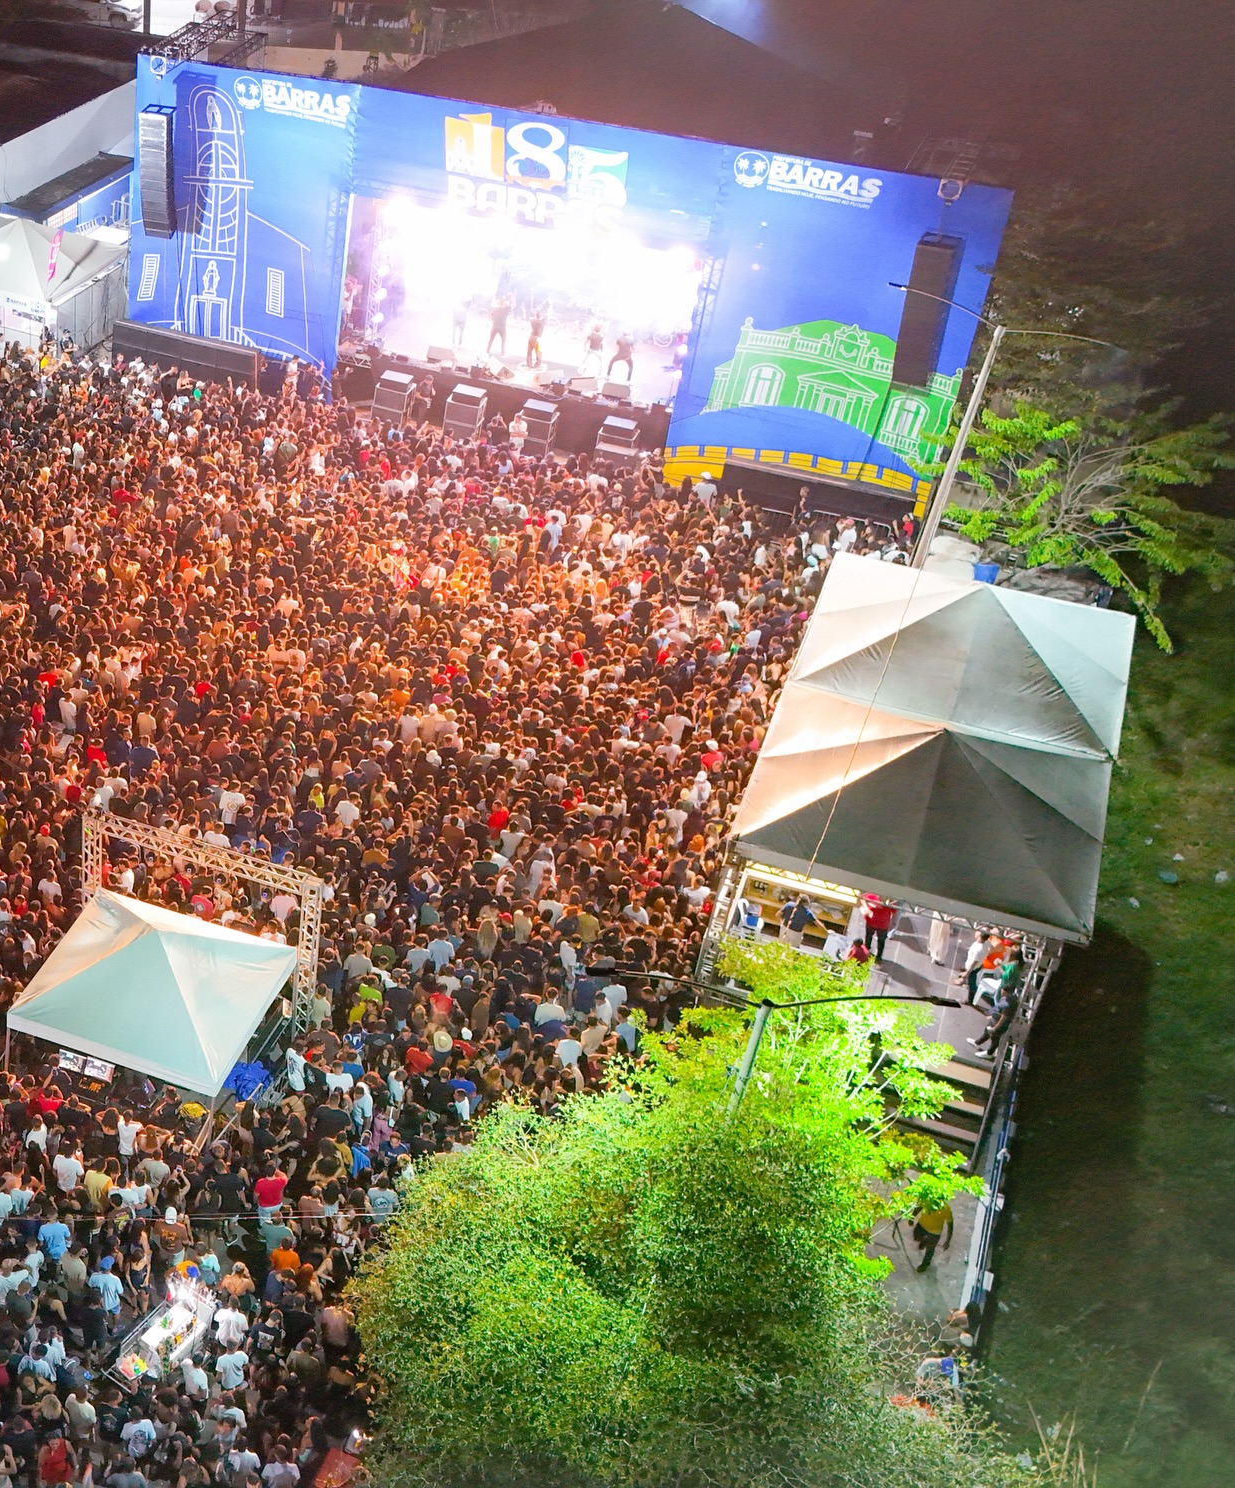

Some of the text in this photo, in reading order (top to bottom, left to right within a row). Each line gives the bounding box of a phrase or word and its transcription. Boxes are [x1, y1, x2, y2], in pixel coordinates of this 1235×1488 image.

[262, 84, 352, 117] BARRAS
[456, 112, 629, 208] 185
[768, 160, 883, 199] BARRAS
